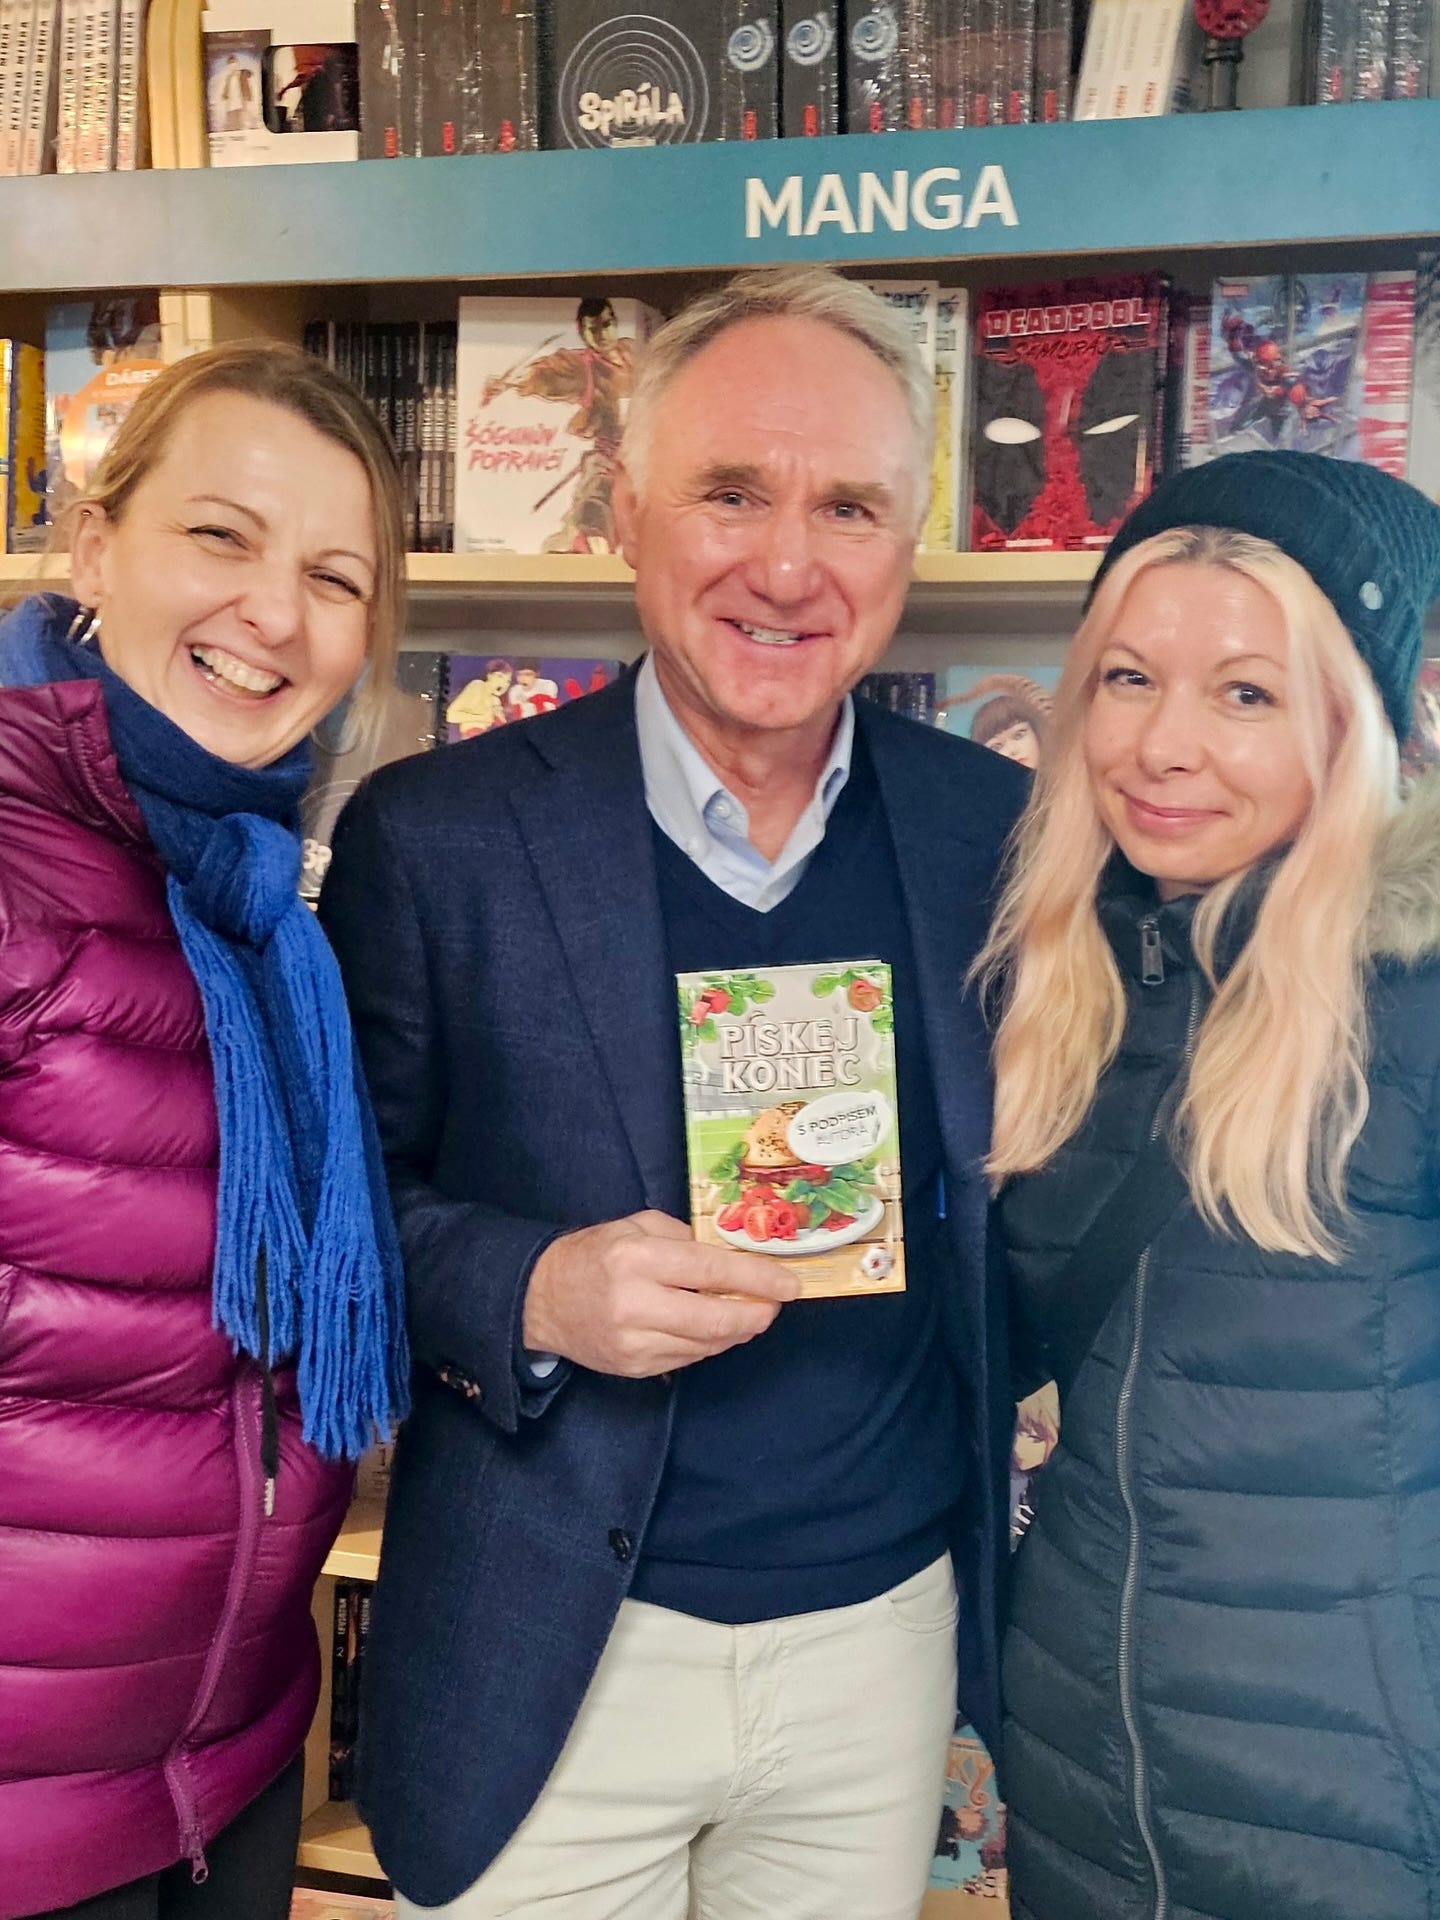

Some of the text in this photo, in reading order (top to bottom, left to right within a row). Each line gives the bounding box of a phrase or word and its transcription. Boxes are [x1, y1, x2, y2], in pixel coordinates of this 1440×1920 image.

[745, 165, 1020, 238] MANGA
[985, 297, 1150, 338] DEADPOOL
[718, 1010, 859, 1060] PÍSKEJ
[721, 1053, 862, 1095] KONEC
